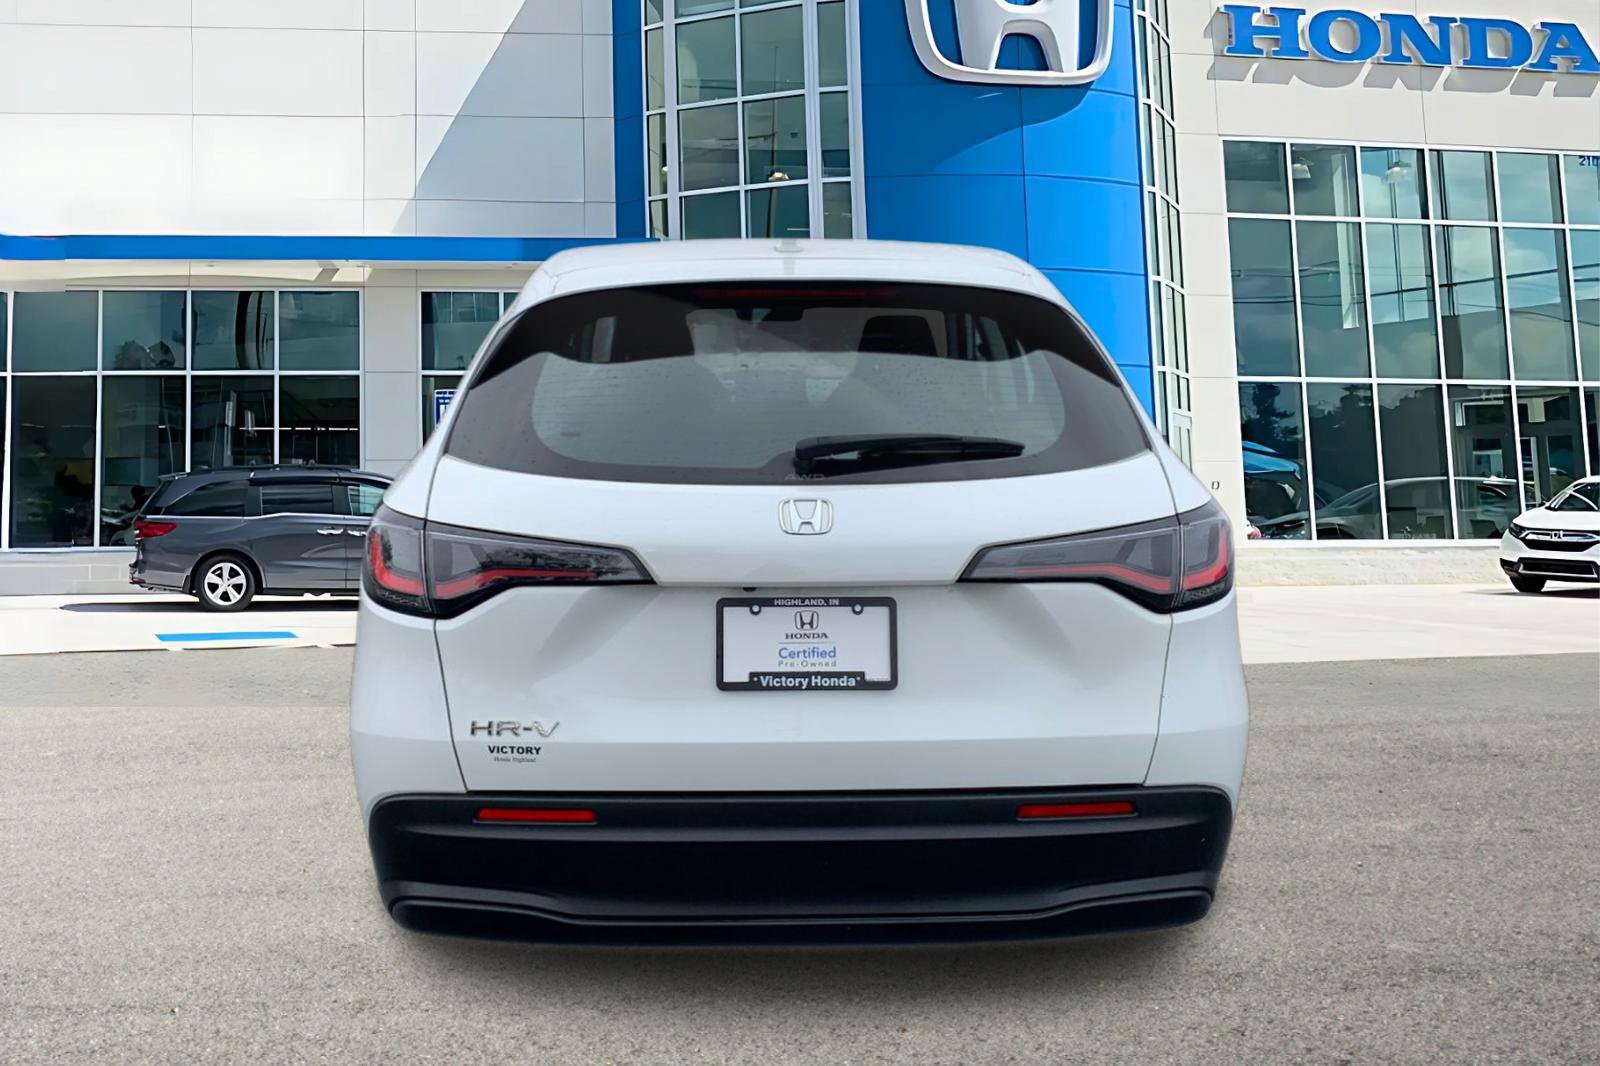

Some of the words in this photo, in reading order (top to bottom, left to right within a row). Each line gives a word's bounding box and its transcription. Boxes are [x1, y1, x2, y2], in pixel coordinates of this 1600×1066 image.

[1223, 4, 1600, 74] HONDA
[830, 598, 840, 606] IN
[785, 632, 829, 640] HONDA
[778, 646, 837, 659] Certified
[759, 675, 808, 689] Victory
[811, 675, 857, 687] Honda
[470, 720, 560, 738] HR-V
[488, 745, 541, 755] VICTORY
